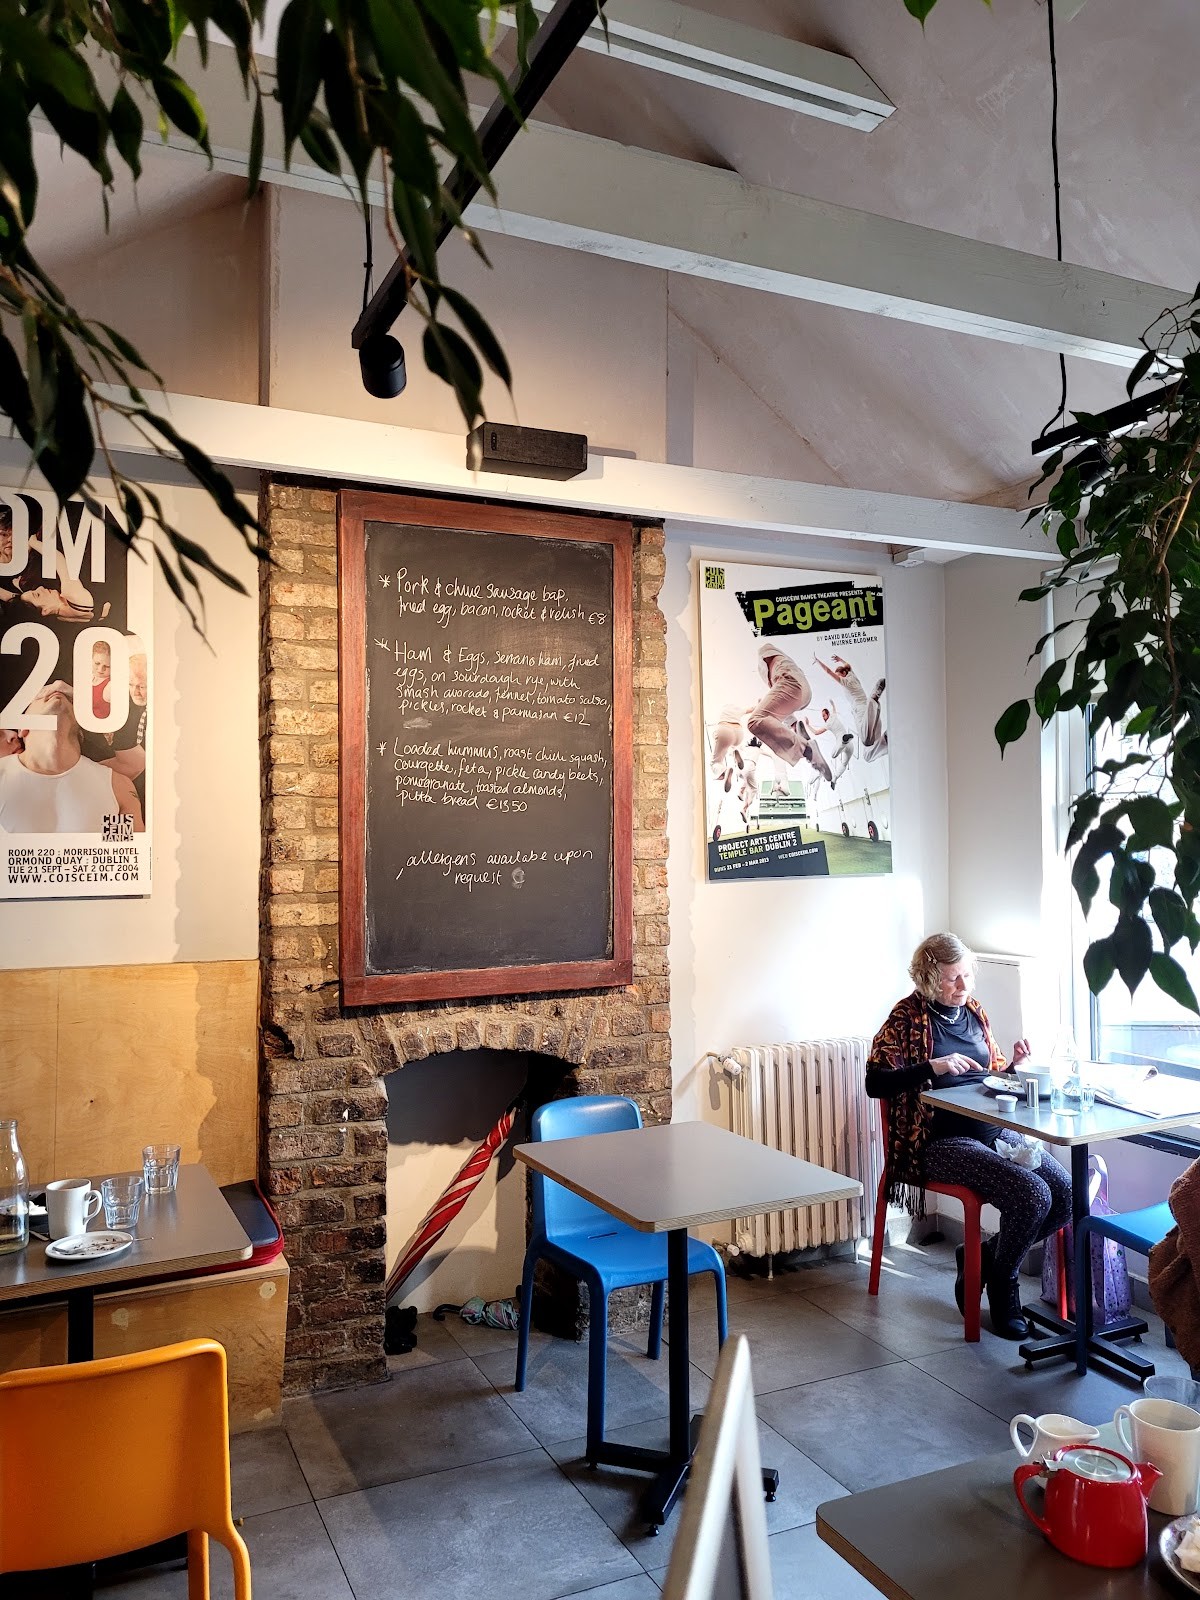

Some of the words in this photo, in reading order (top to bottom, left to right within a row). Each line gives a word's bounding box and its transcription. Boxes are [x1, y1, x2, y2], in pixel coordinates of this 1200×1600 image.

[397, 567, 429, 594] Pork
[434, 577, 442, 598] &
[839, 589, 864, 597] PRESENTS
[398, 595, 426, 618] fried
[501, 603, 537, 620] rocket
[540, 606, 547, 622] &
[549, 604, 585, 621] relish
[588, 612, 608, 625] €8
[753, 591, 878, 631] Pageant
[824, 633, 840, 641] DAVID
[841, 631, 861, 639] BOLGER
[394, 640, 432, 664] Ham
[442, 644, 452, 664] &
[567, 654, 600, 673] fried
[431, 671, 446, 682] on
[550, 677, 581, 690] with
[536, 692, 576, 705] tomato
[451, 702, 488, 718] rocket
[563, 708, 591, 726] €12
[393, 737, 443, 757] Loaded
[503, 747, 533, 760] roast
[495, 763, 530, 781] pickle
[475, 780, 511, 794] toasted
[441, 792, 480, 810] bread
[8, 848, 34, 856] ROOM
[37, 848, 55, 856] 220
[63, 847, 110, 856] MORRISON
[112, 847, 139, 855] HOTEL
[718, 840, 749, 853] PROJECT
[750, 836, 768, 846] ARTS
[768, 831, 797, 843] CENTRE
[719, 850, 748, 861] TEMPLE
[749, 846, 764, 855] BAR
[765, 840, 791, 852] DUBLIN
[8, 856, 52, 866] ORMOND
[55, 856, 83, 866] QUAY
[92, 855, 130, 864] DUBLIN
[133, 855, 139, 864] 1
[8, 866, 25, 874] TUE
[27, 865, 38, 873] 21
[41, 865, 62, 873] SEPT
[72, 864, 89, 873] SAT
[91, 864, 96, 872] 2
[98, 864, 115, 872] OCT
[117, 864, 139, 872] 2004
[406, 850, 477, 876] allergens
[553, 850, 593, 865] upon
[8, 872, 139, 884] WWW.COISCEIM.COM
[455, 871, 501, 892] request
